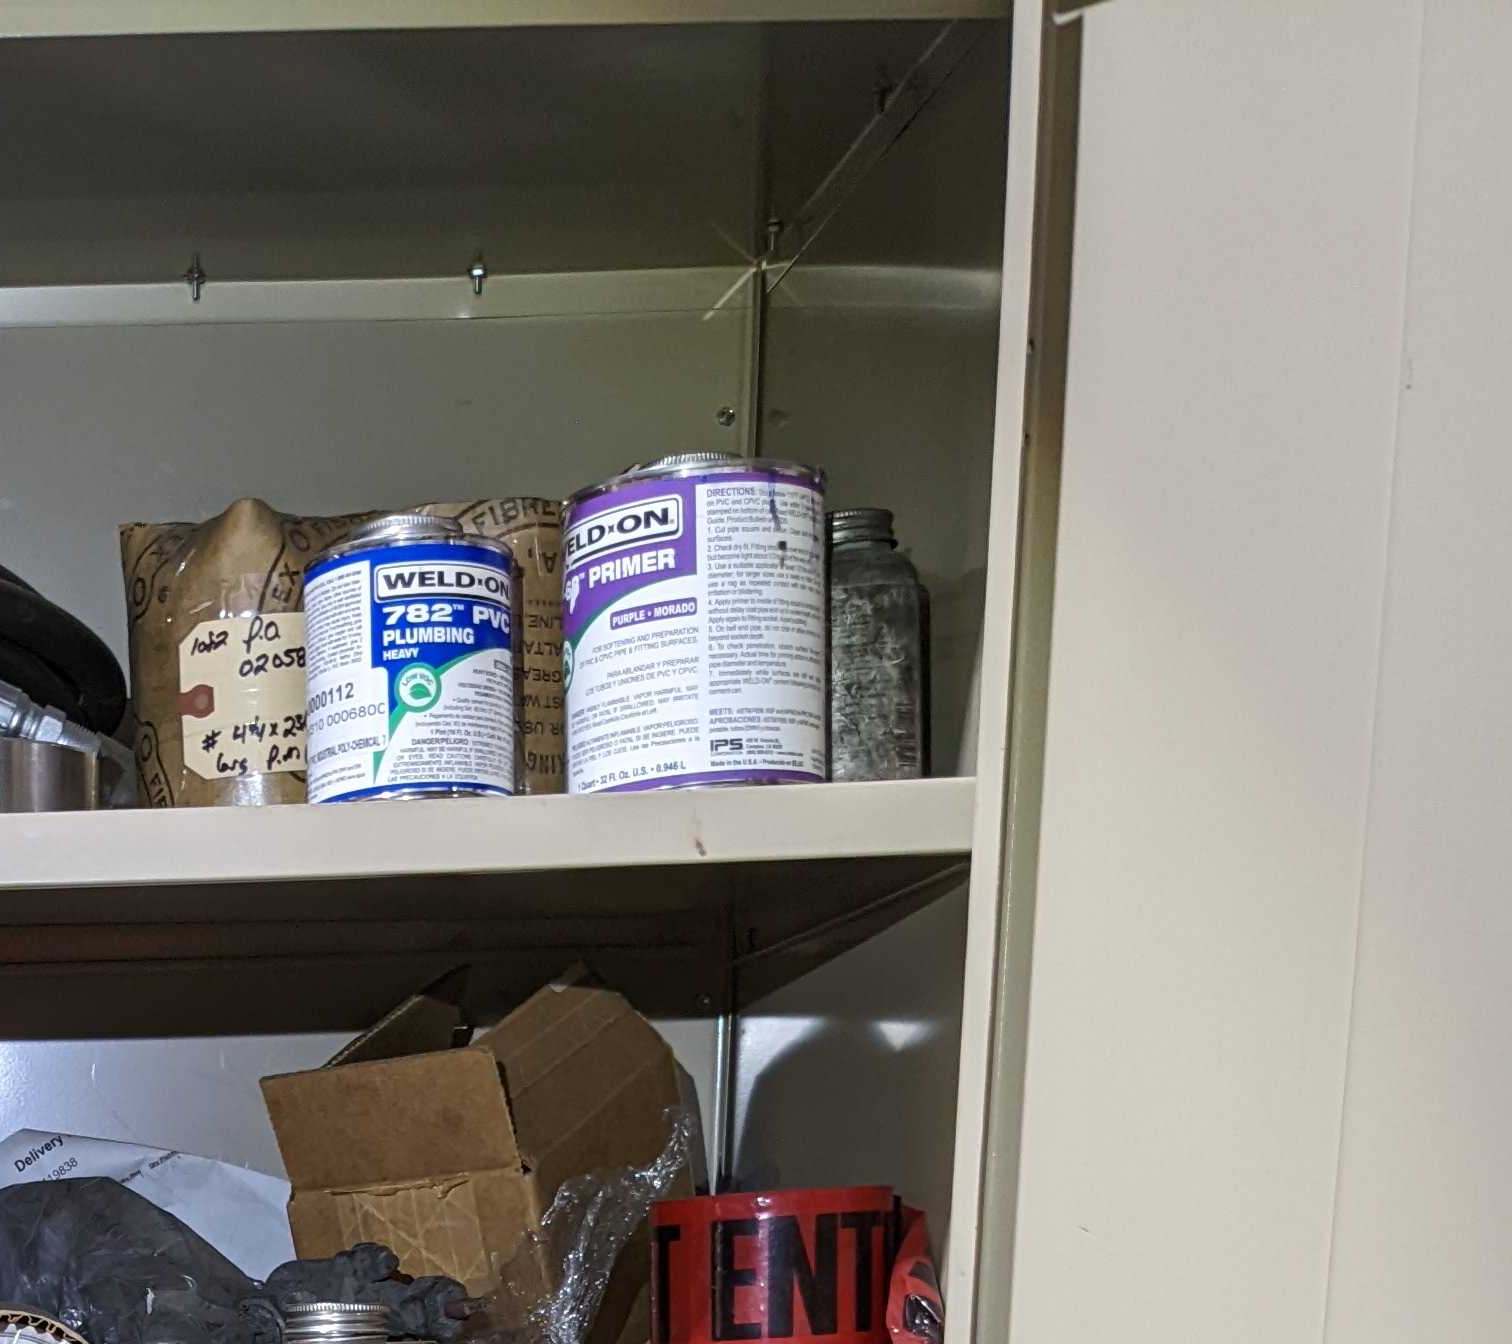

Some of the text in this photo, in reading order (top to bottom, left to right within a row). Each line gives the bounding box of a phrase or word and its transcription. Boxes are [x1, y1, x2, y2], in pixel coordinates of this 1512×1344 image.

[589, 548, 676, 589] PRIMER
[472, 604, 511, 635] PVC
[612, 602, 696, 627] PURPLE MORADO
[382, 626, 475, 647] PLUMBING
[382, 647, 420, 662] HEAVY
[709, 738, 744, 752] IPS
[13, 1133, 65, 1173] Delivery
